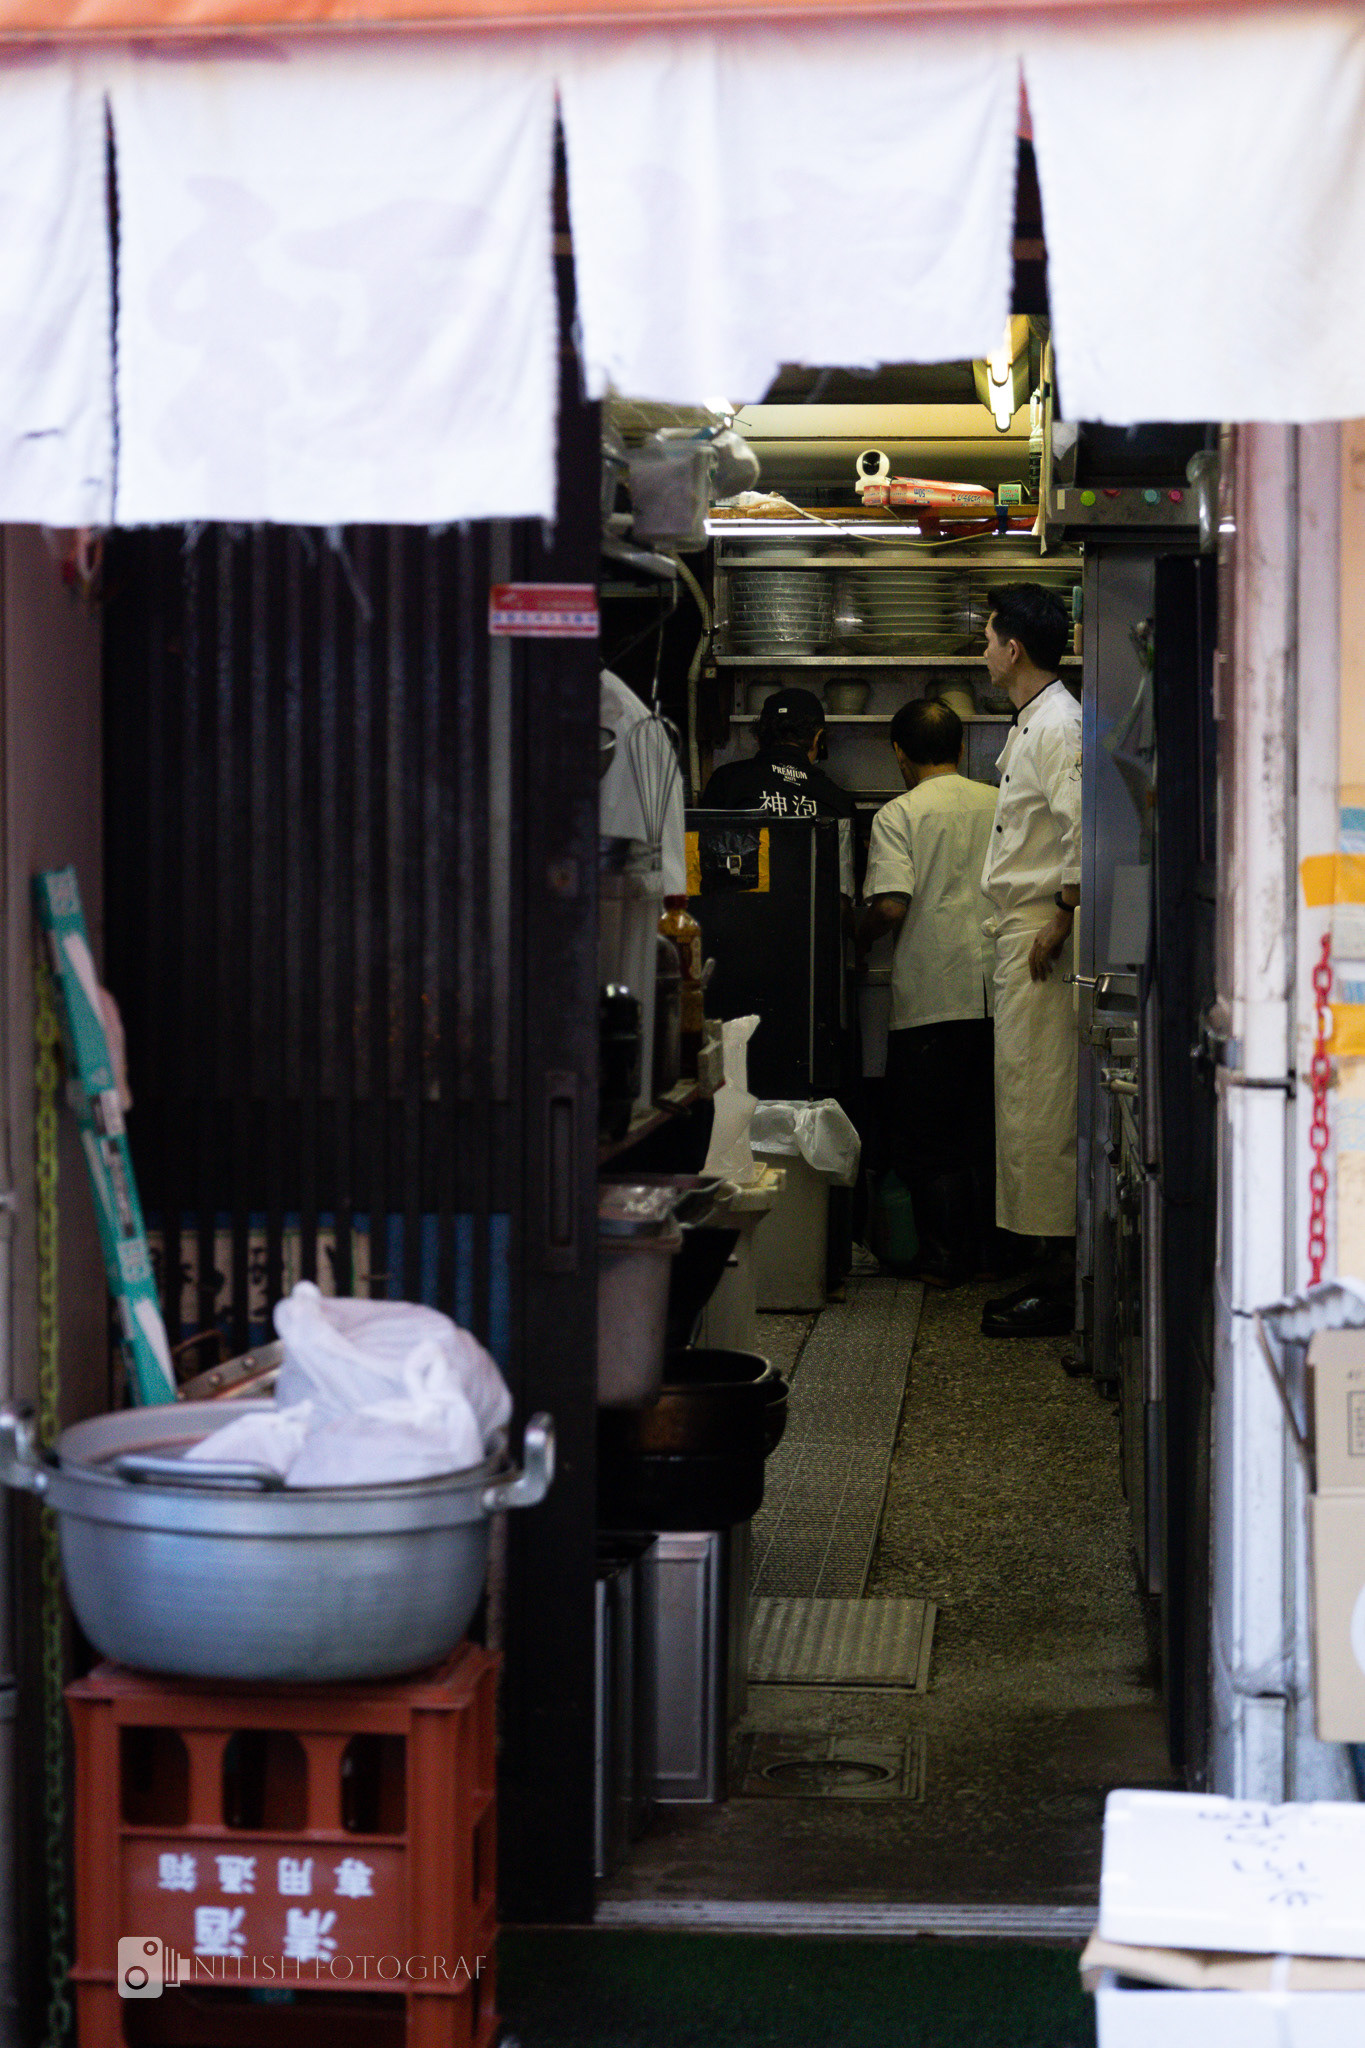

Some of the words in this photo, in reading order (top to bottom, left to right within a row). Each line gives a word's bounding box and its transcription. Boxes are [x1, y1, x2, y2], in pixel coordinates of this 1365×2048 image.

[771, 764, 808, 780] PREMIUM
[759, 790, 817, 816] 神泡
[193, 1905, 338, 1963] 清酒
